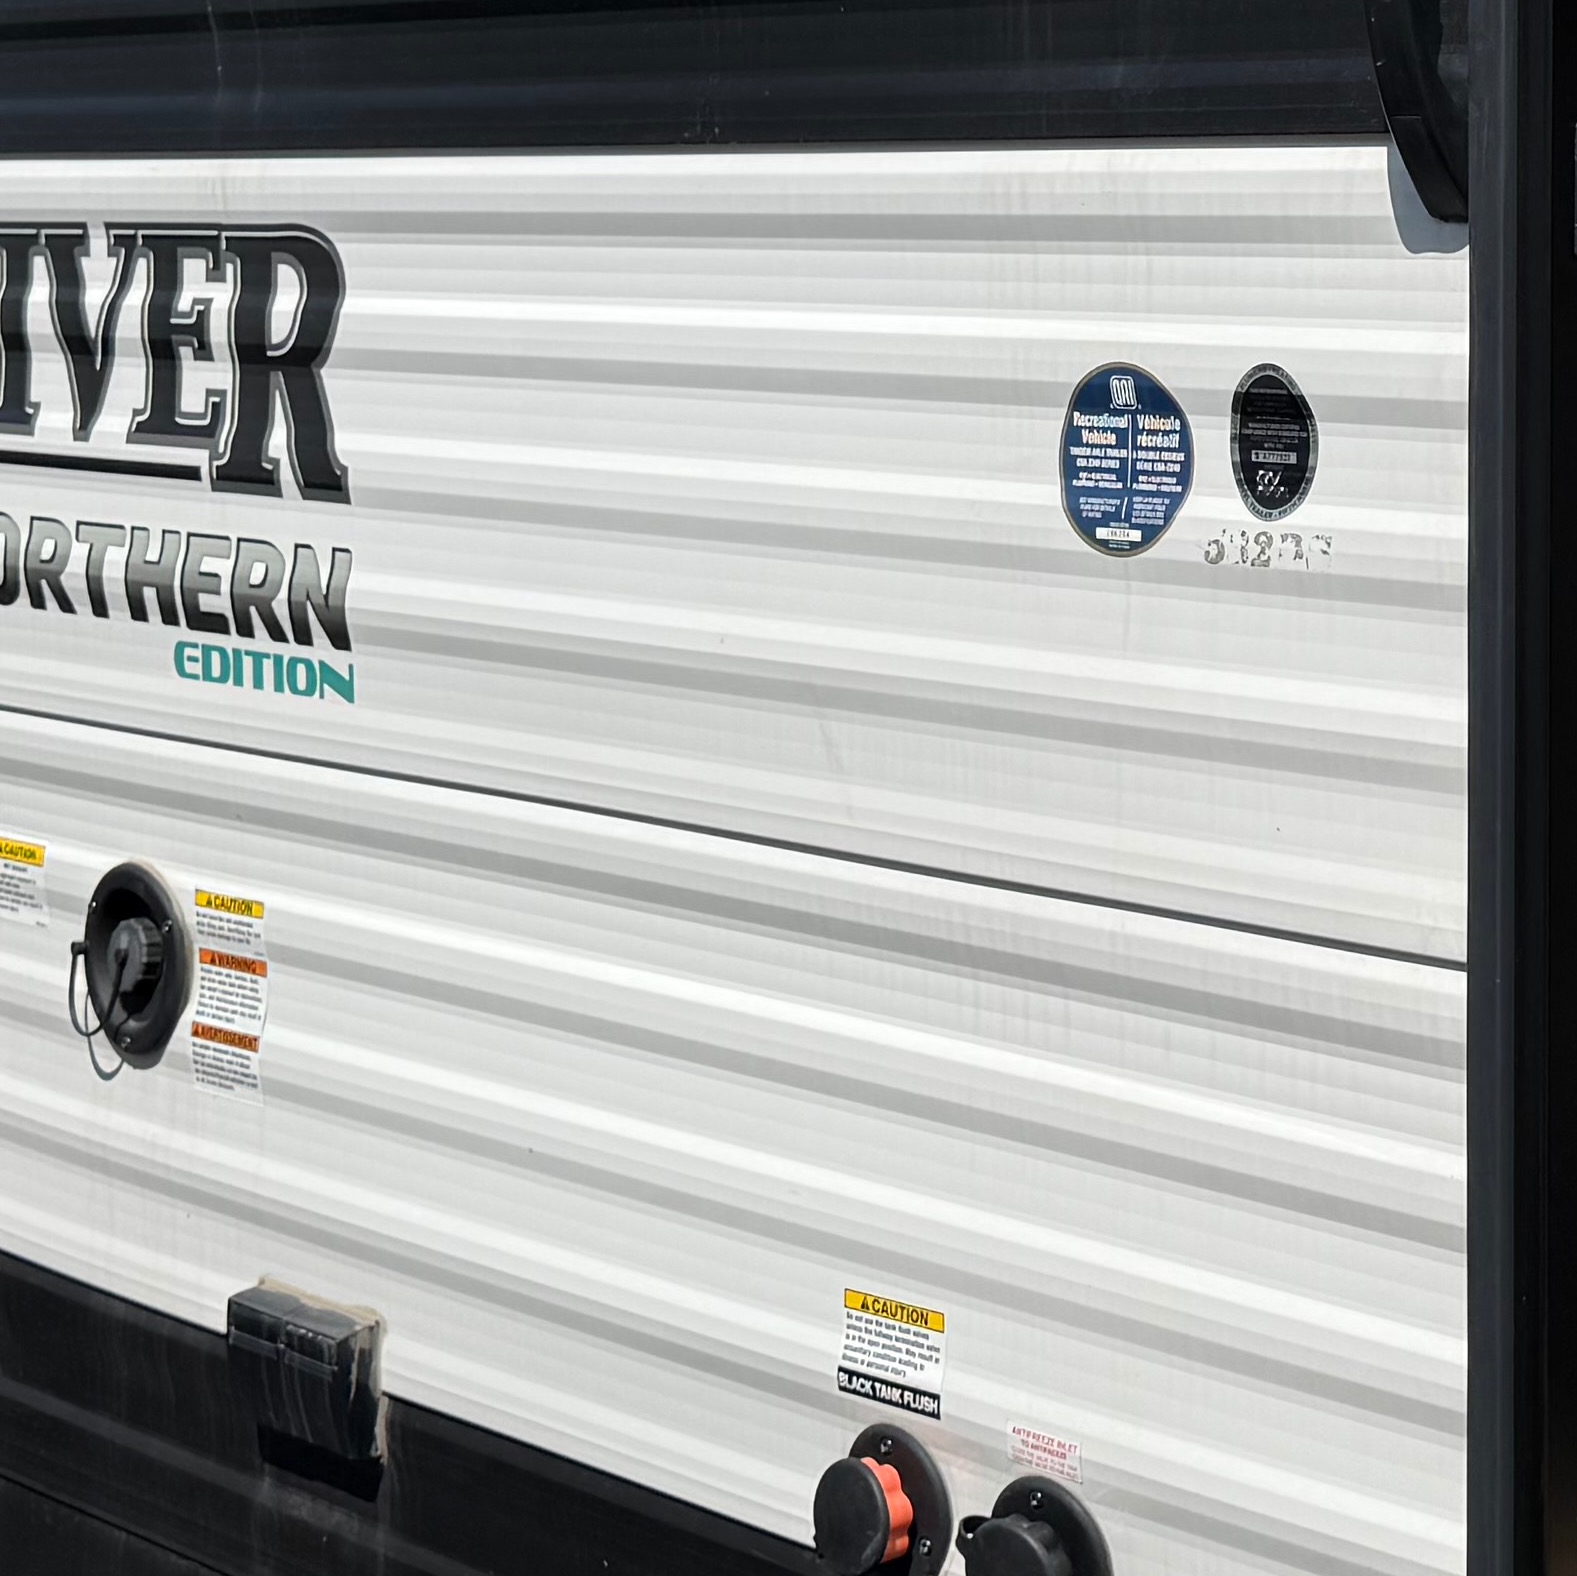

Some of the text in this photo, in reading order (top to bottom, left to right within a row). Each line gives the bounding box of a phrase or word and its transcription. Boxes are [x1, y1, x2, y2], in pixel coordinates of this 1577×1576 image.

[1073, 411, 1128, 428] Recreational
[1082, 429, 1116, 445] Vehicle
[174, 641, 355, 704] EDITION
[214, 895, 253, 916] CAUTION
[872, 1298, 928, 1326] CAUTION
[838, 1371, 938, 1414] BLACK TANK FLUSH
